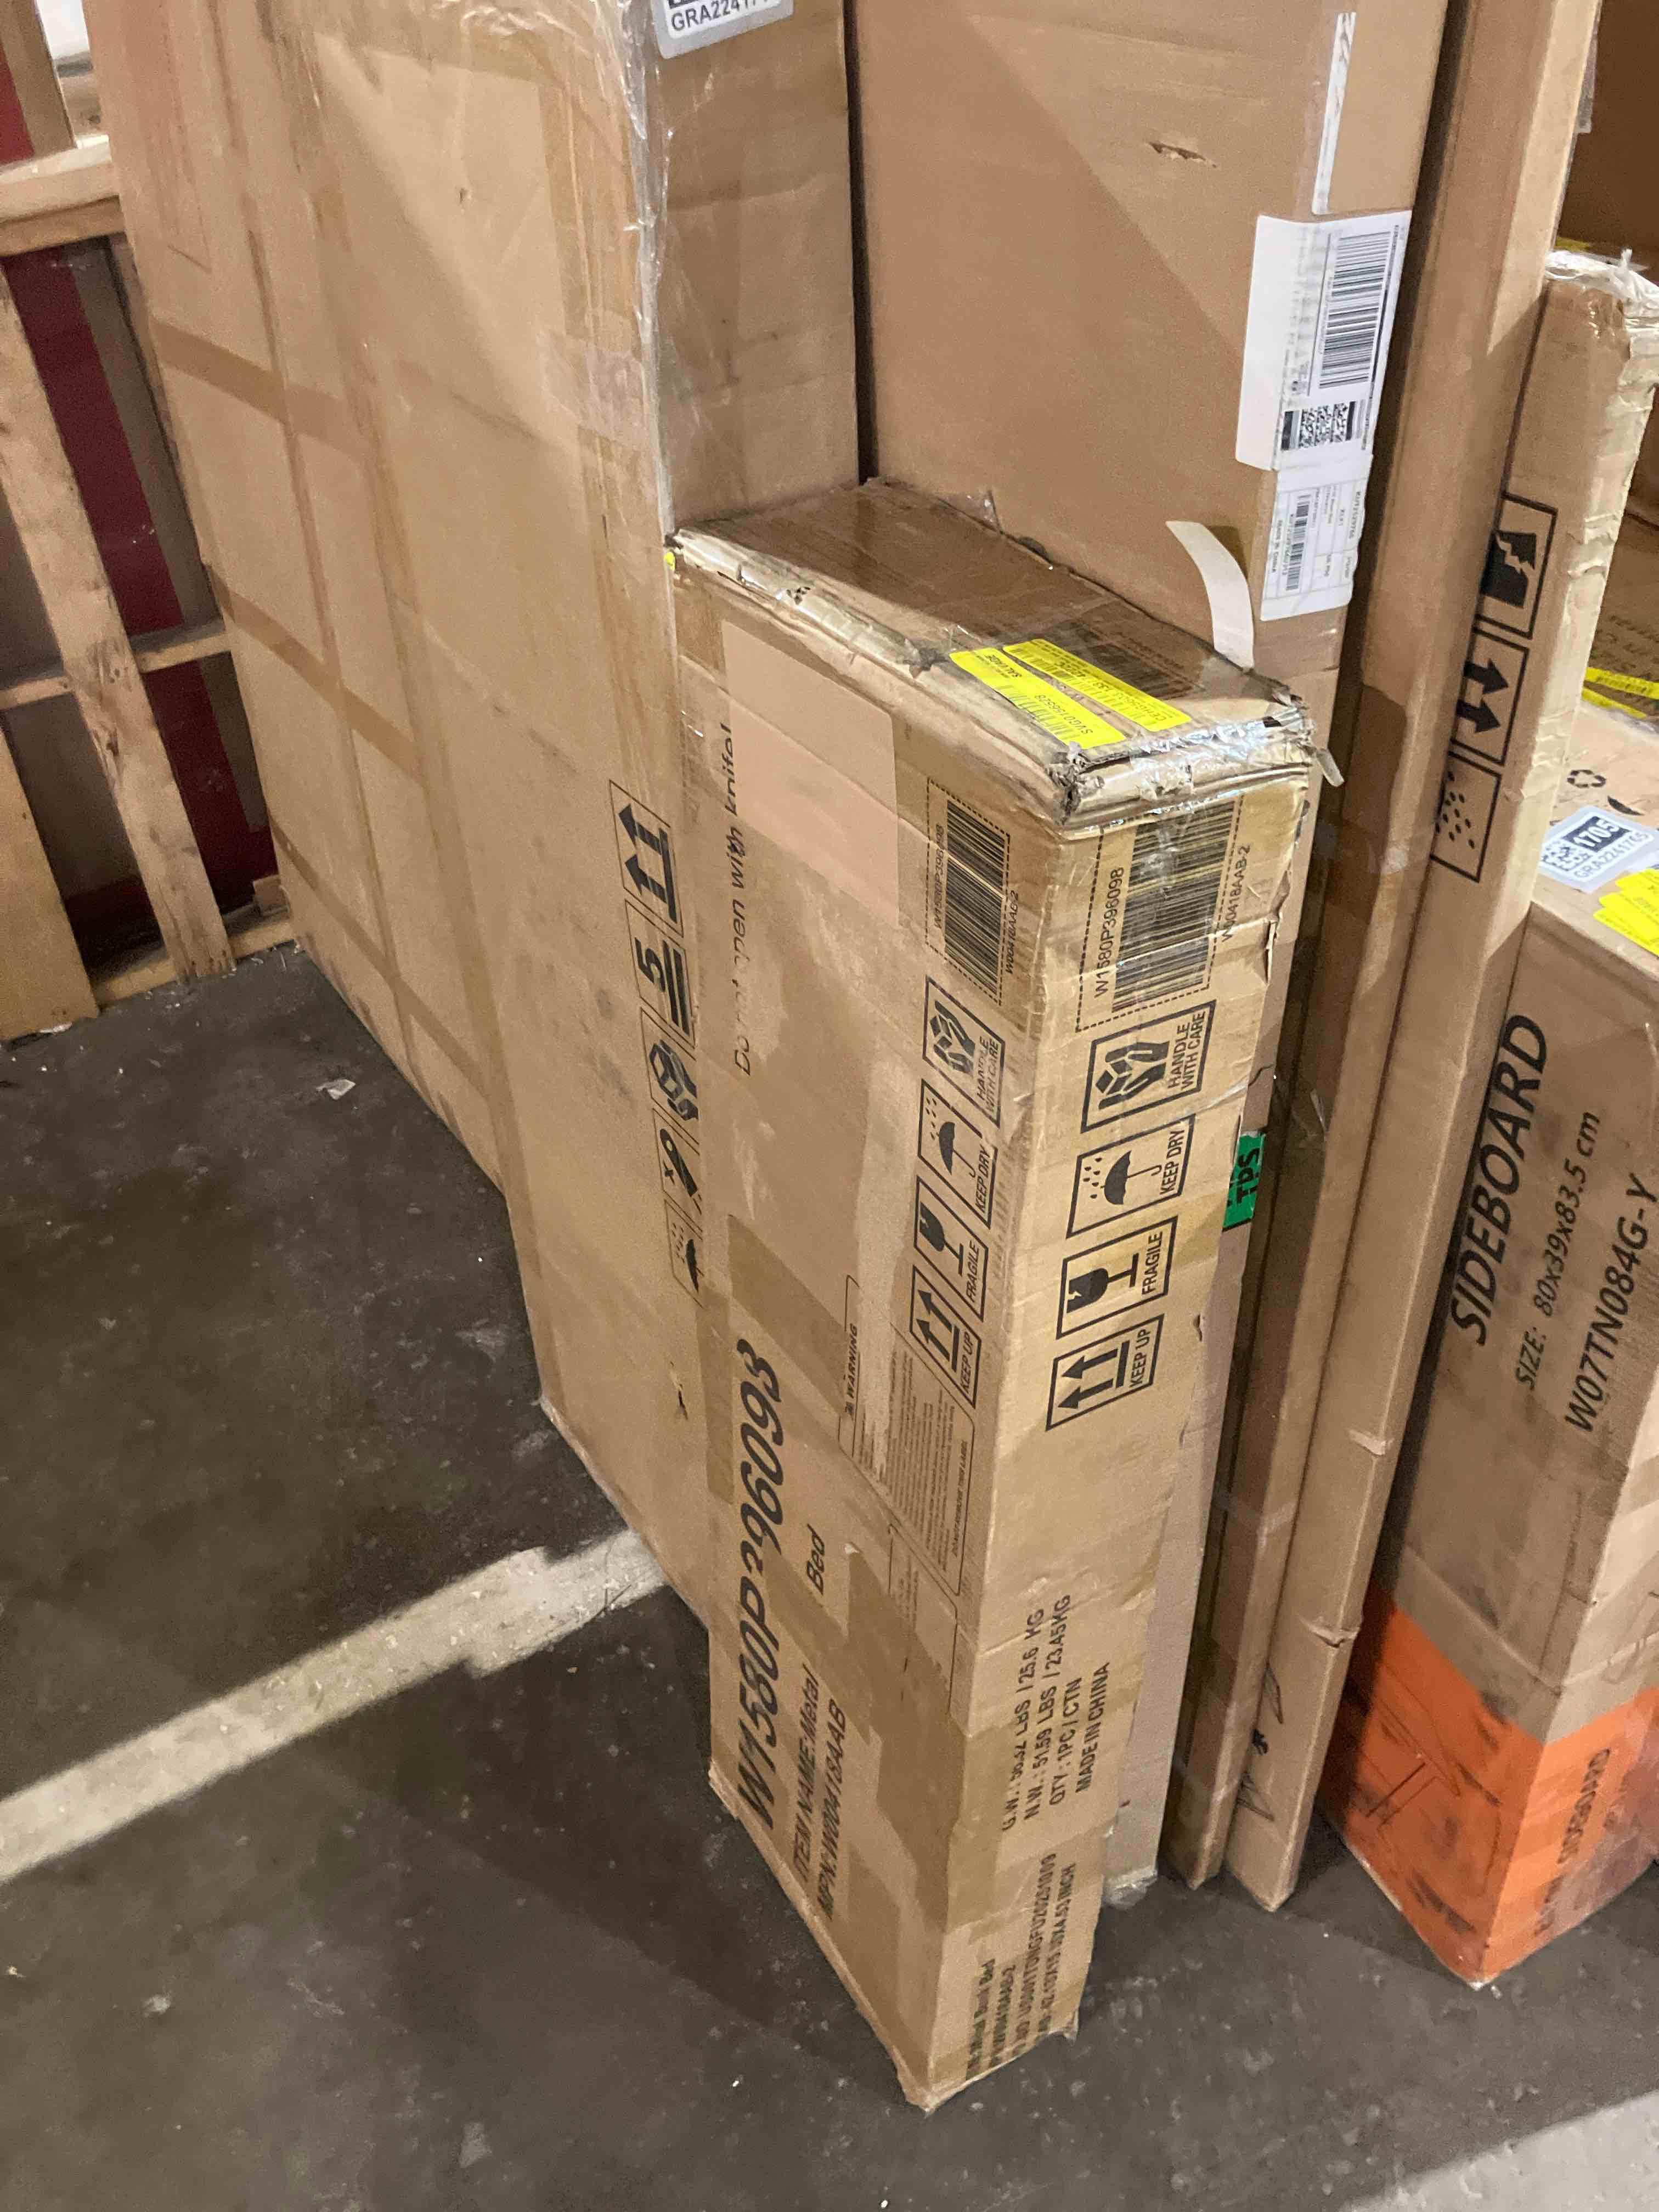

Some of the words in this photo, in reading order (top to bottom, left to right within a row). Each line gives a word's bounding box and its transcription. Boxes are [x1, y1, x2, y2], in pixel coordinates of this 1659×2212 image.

[1571, 817, 1621, 849] 1705
[726, 826, 745, 889] with
[1093, 866, 1125, 998] W1580P396098
[1187, 1011, 1206, 1050] CARE
[977, 1036, 989, 1101] HANDLE
[989, 1038, 1000, 1077] CARE
[1167, 1022, 1190, 1089] HANDLE
[1181, 1052, 1199, 1091] WITH
[985, 1076, 996, 1112] WITH
[979, 1143, 991, 1178] DRY
[1166, 1129, 1186, 1160] DRY
[975, 1176, 988, 1214] KEEP
[1159, 1160, 1180, 1195] KEEP
[1451, 1013, 1548, 1346] SIDEBOARD
[966, 1239, 980, 1303] FRAGILE
[1142, 1231, 1163, 1296] FRAGILE
[1515, 1323, 1548, 1392] SIZE:
[1533, 1161, 1587, 1319] 80x39x83.5
[1579, 1111, 1601, 1159] cm
[1565, 1171, 1659, 1434] W07TN084G-Y
[962, 1331, 973, 1355] UP
[1136, 1328, 1151, 1350] UP
[847, 1323, 859, 1398] WARNING
[960, 1354, 971, 1394] KEEP
[1130, 1353, 1147, 1388] KEEP
[804, 1523, 826, 1596] Bed
[1015, 1699, 1031, 1736] LBS
[1025, 1608, 1045, 1640] KG
[1088, 1661, 1110, 1722] CHINA
[1037, 1684, 1058, 1724] LBS
[1032, 1728, 1053, 1770] 51.59
[1085, 1721, 1101, 1748] IN
[1075, 1746, 1097, 1793] MADE
[793, 1818, 811, 1883] ITEM
